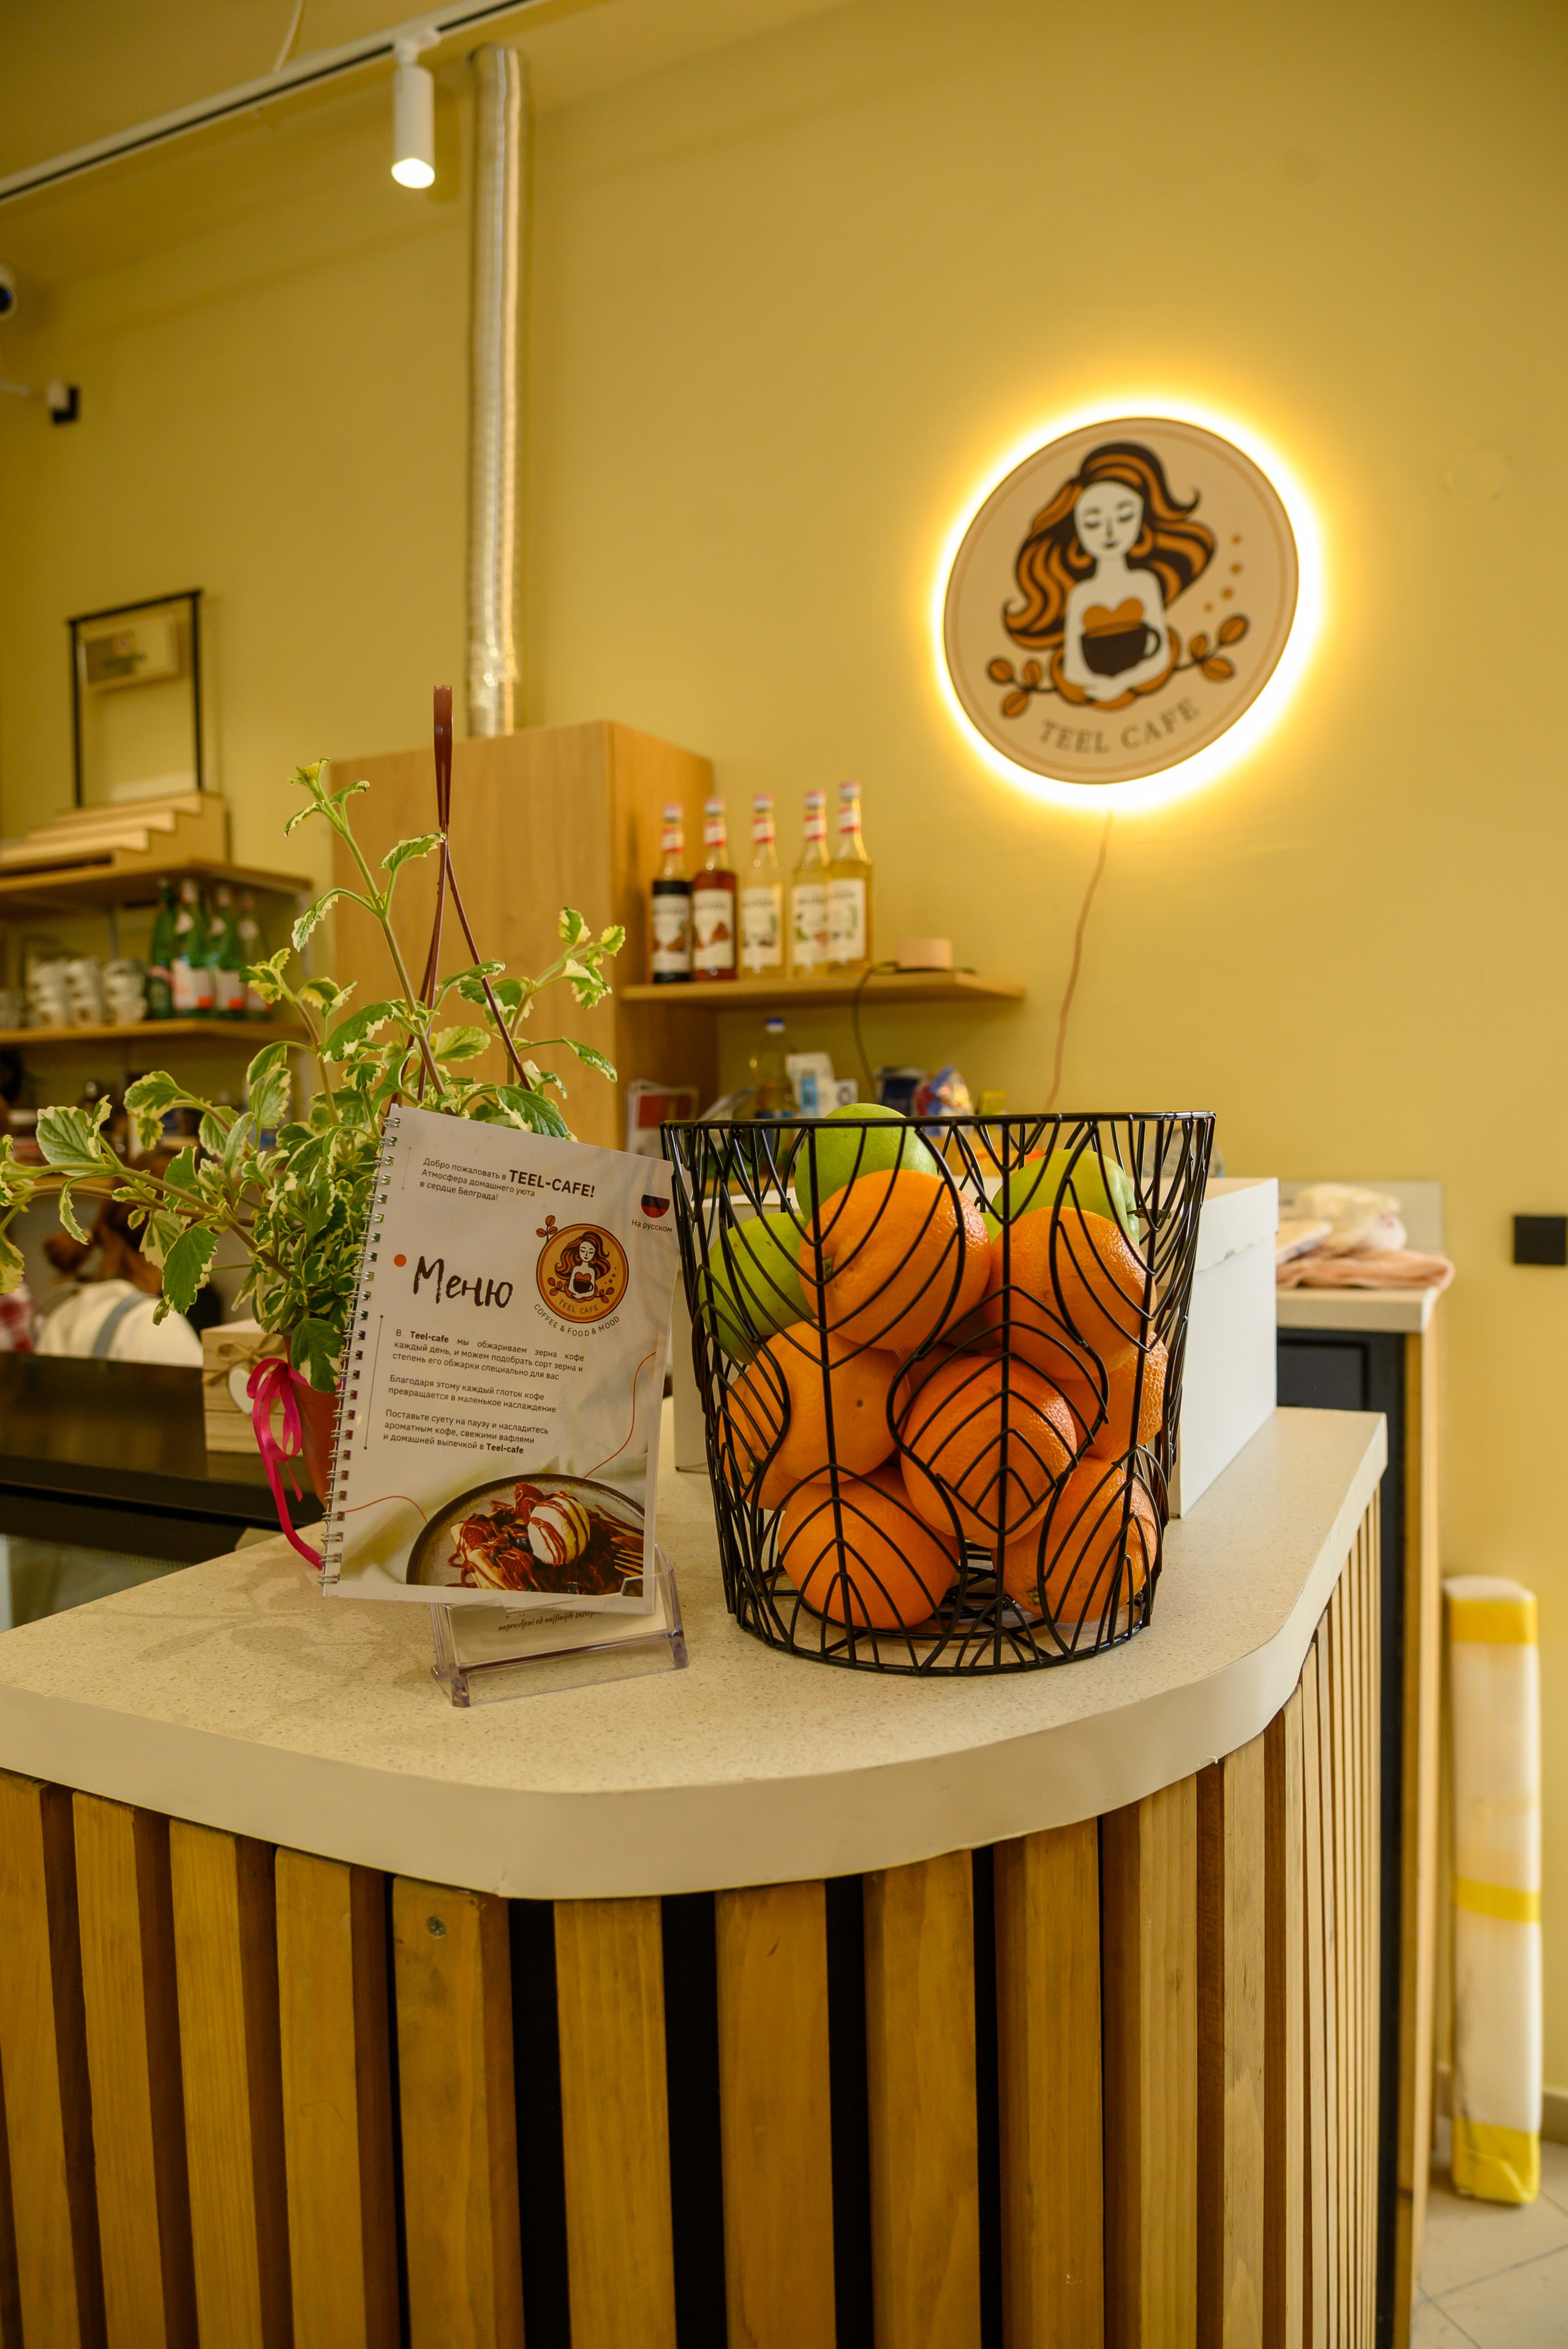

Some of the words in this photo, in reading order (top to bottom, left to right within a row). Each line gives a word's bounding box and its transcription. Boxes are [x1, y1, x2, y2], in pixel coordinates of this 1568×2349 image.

[1039, 717, 1112, 753] TEEL
[1120, 696, 1201, 750] CAFE
[422, 1169, 467, 1184] Атмосфера
[469, 1180, 514, 1193] домашнего
[423, 1158, 450, 1169] Добро
[452, 1165, 500, 1178] пожаловать
[510, 1169, 595, 1197] TEEL-CAFE!
[427, 1183, 456, 1193] сердце
[458, 1187, 498, 1201] Белграда!
[631, 1219, 641, 1227] На
[643, 1222, 673, 1233] русском
[413, 1256, 513, 1308] Меню
[559, 1299, 576, 1313] TEEL
[580, 1304, 599, 1314] CAFE
[534, 1304, 559, 1329] COFFEE
[568, 1327, 590, 1337] FOOD
[598, 1316, 620, 1332] MOOD
[394, 1342, 428, 1351] каждый
[429, 1347, 451, 1355] день,
[491, 1355, 532, 1365] подобрать
[410, 1331, 448, 1343] Teel-cafe
[478, 1341, 527, 1354] обжариваем
[393, 1354, 426, 1362] степень
[444, 1359, 479, 1370] обжарки
[481, 1365, 528, 1376] специально
[390, 1374, 434, 1387] Благодаря
[436, 1382, 461, 1392] этому
[462, 1386, 494, 1394] каждый
[496, 1389, 522, 1398] глоток
[388, 1388, 448, 1400] превращается
[458, 1397, 501, 1406] маленькое
[503, 1401, 556, 1412] наслаждение
[385, 1422, 432, 1433] ароматным
[435, 1428, 458, 1436] кофе,
[461, 1431, 497, 1439] свежими
[499, 1435, 534, 1444] вафлями
[386, 1409, 429, 1421] Поставьте
[431, 1416, 454, 1425] суету
[468, 1420, 490, 1429] паузу
[499, 1423, 548, 1434] насладитесь
[390, 1435, 434, 1444] домашней
[437, 1439, 477, 1449] выпечкой
[486, 1443, 524, 1454] Teel-cafe
[499, 1618, 534, 1632] napravljeni
